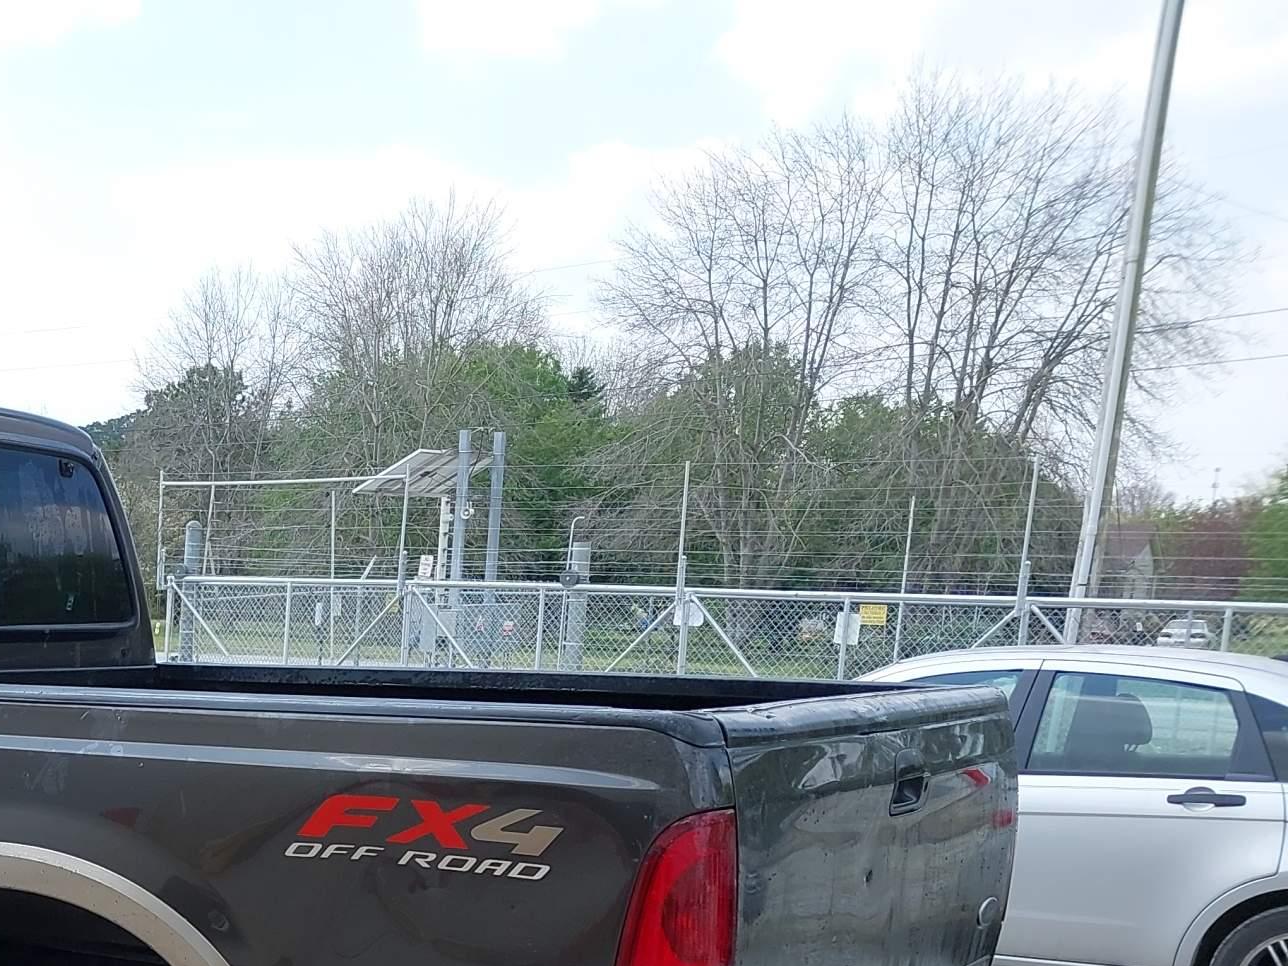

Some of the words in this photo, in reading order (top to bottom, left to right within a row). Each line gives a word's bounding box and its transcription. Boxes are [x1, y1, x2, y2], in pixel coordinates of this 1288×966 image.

[296, 794, 564, 857] FX4
[284, 842, 385, 860] OFF
[397, 850, 551, 881] ROAD
